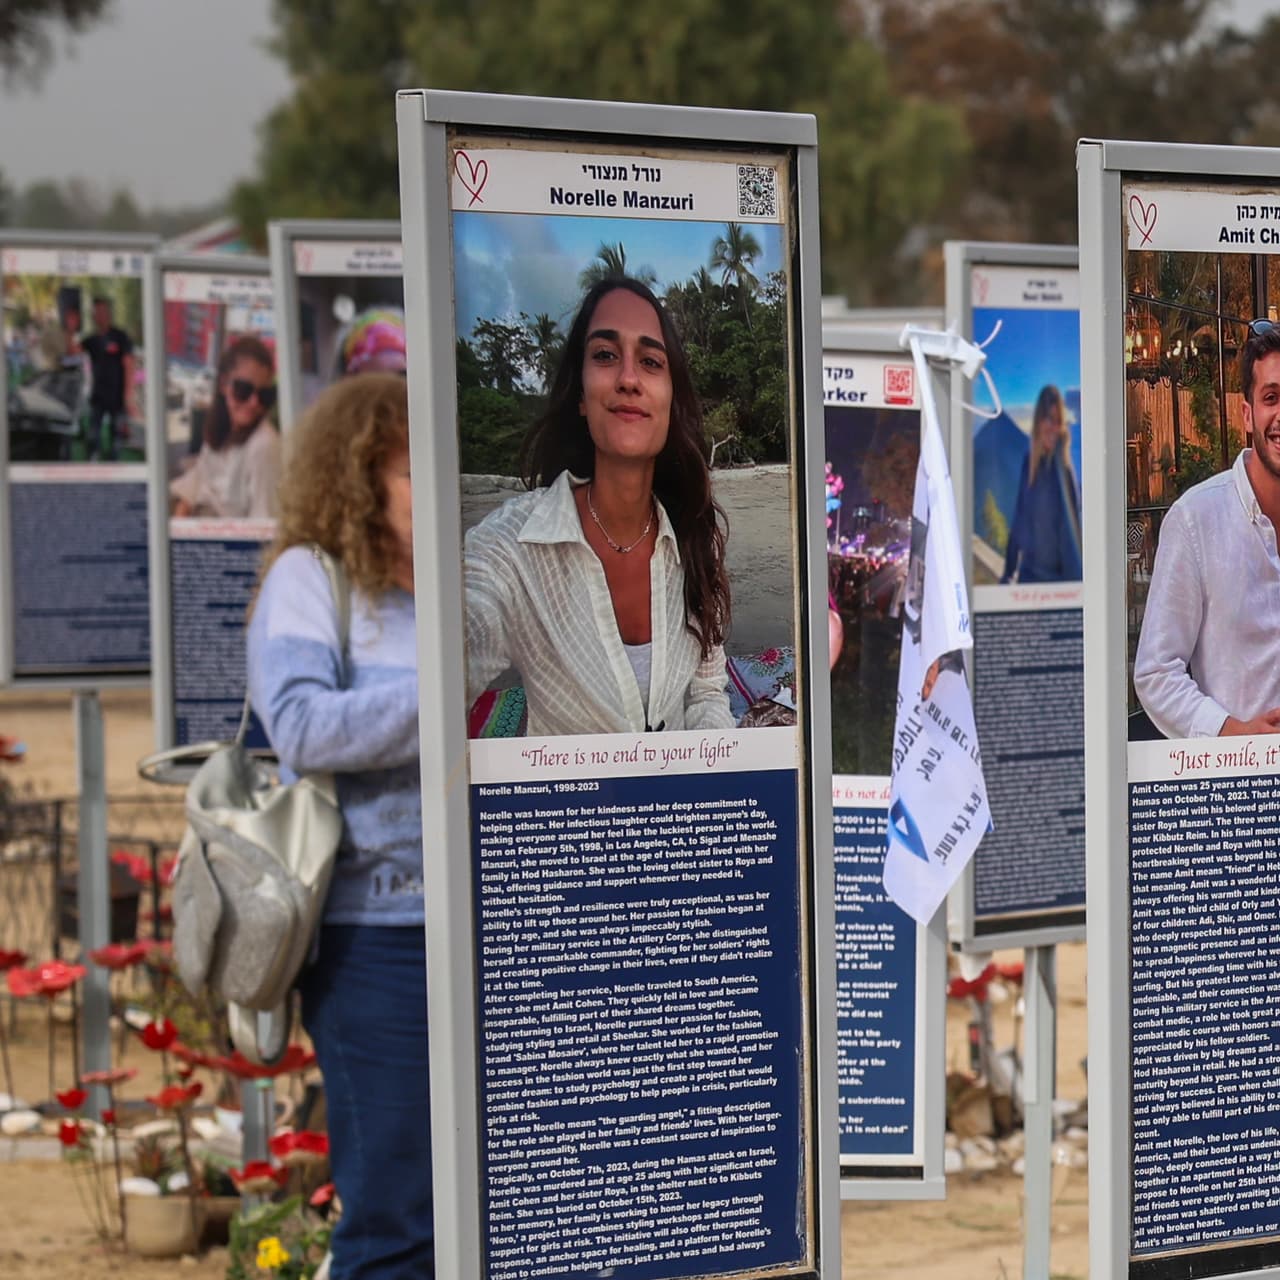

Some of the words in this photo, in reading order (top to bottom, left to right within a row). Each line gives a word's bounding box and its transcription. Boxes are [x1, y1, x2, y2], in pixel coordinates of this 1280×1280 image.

[582, 164, 627, 180] מנצורי
[631, 163, 660, 182] נורל
[550, 187, 616, 206] Norelle
[623, 190, 693, 210] Manzuri
[1236, 205, 1256, 221] כהן
[1218, 226, 1254, 243] Amit
[521, 744, 568, 766] “There
[575, 748, 585, 764] is
[591, 751, 608, 763] no
[612, 740, 642, 762] end
[643, 747, 656, 761] to
[659, 747, 694, 769] your
[698, 737, 739, 768] light”
[1169, 750, 1210, 773] “Just
[1214, 741, 1260, 768] smile,
[479, 786, 511, 795] Norelle
[513, 784, 551, 793] Manzuri,
[553, 781, 599, 792] 1998-2023
[1131, 784, 1151, 793] Amit
[1153, 783, 1179, 792] Cohen
[1180, 783, 1197, 791] was
[1199, 780, 1210, 789] 25
[1211, 781, 1234, 791] years
[1236, 778, 1249, 787] old
[1250, 777, 1272, 786] when
[844, 788, 854, 800] is
[858, 788, 876, 800] not
[479, 810, 512, 820] Norelle
[534, 808, 564, 817] known
[566, 807, 579, 815] for
[580, 806, 595, 815] her
[597, 804, 636, 814] kindness
[637, 803, 654, 812] and
[655, 802, 670, 811] her
[671, 801, 692, 811] deep
[694, 798, 746, 809] commitment
[748, 798, 757, 806] to
[836, 874, 882, 884] friendship
[836, 884, 860, 894] loyal.
[847, 924, 876, 932] where
[878, 923, 894, 932] she
[846, 933, 878, 942] passed
[880, 932, 896, 941] the
[860, 942, 882, 950] went
[884, 942, 894, 951] to
[844, 952, 868, 961] great
[838, 962, 850, 970] as
[850, 962, 858, 970] a
[859, 961, 882, 970] chief
[852, 981, 898, 989] encounter
[852, 990, 890, 999] terrorist
[860, 1038, 876, 1047] the
[876, 1038, 901, 1048] party
[847, 1096, 906, 1105] subordinates
[845, 1124, 853, 1134] it
[854, 1124, 864, 1134] is
[865, 1125, 880, 1134] not
[1134, 1237, 1160, 1248] Amit's
[1161, 1234, 1184, 1245] smile
[1185, 1231, 1200, 1241] will
[1202, 1229, 1230, 1239] forever
[1232, 1226, 1254, 1235] shine
[1256, 1223, 1263, 1232] in
[1264, 1223, 1278, 1231] our
